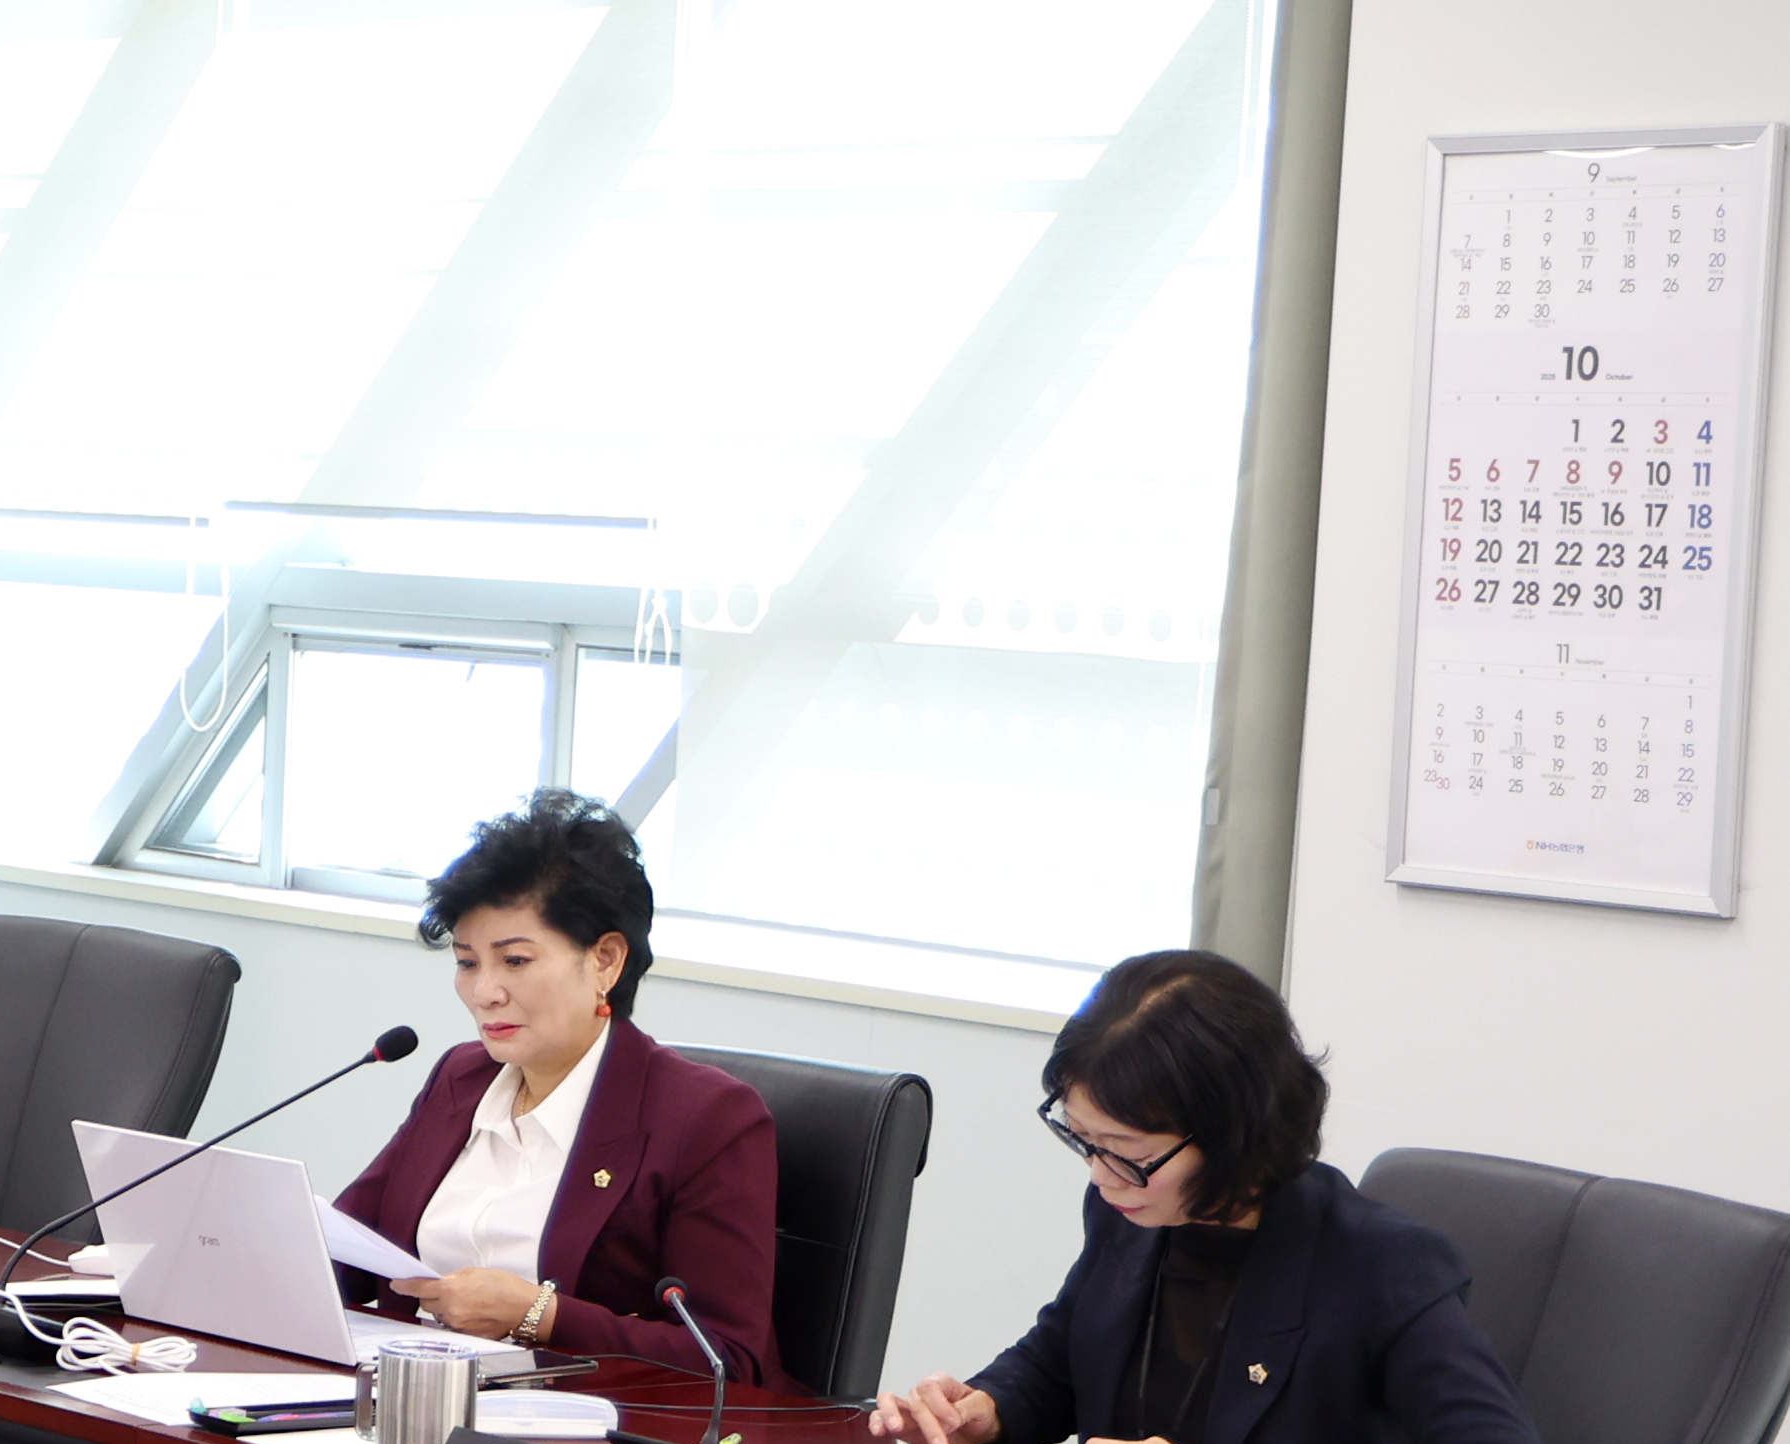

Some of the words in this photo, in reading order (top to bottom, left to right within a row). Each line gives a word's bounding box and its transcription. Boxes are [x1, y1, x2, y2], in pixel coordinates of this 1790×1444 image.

[1588, 163, 1600, 183] 9
[1544, 208, 1553, 223] 2
[1586, 207, 1595, 222] 3
[1628, 206, 1637, 220] 4
[1672, 205, 1681, 220] 5
[1716, 204, 1725, 218] 6
[1464, 234, 1472, 248] 7
[1502, 233, 1511, 248] 8
[1543, 232, 1552, 246] 9
[1582, 231, 1596, 246] 10
[1626, 230, 1636, 244] 11
[1668, 229, 1681, 244] 12
[1713, 227, 1726, 243] 13
[1460, 256, 1472, 272] 14
[1500, 257, 1512, 271] 15
[1540, 256, 1552, 271] 16
[1581, 255, 1594, 269] 17
[1623, 254, 1636, 269] 18
[1667, 253, 1680, 268] 19
[1708, 252, 1726, 268] 20
[1458, 281, 1470, 296] 21
[1496, 280, 1511, 295] 22
[1536, 279, 1552, 294] 23
[1577, 279, 1593, 294] 24
[1619, 278, 1636, 293] 25
[1662, 278, 1679, 293] 26
[1707, 277, 1724, 292] 27
[1455, 304, 1471, 319] 28
[1495, 304, 1510, 319] 29
[1534, 303, 1550, 318] 30
[1562, 345, 1599, 381] 10
[1610, 419, 1625, 444] 2
[1653, 419, 1668, 445] 3
[1697, 420, 1713, 445] 4
[1448, 458, 1461, 482] 5
[1486, 459, 1500, 483] 6
[1527, 459, 1540, 483] 7
[1566, 459, 1580, 485] 8
[1608, 460, 1623, 485] 9
[1646, 461, 1671, 486] 10
[1693, 462, 1711, 487] 11
[1442, 497, 1463, 522] 12
[1480, 499, 1502, 523] 13
[1520, 500, 1542, 524] 14
[1560, 501, 1582, 526] 15
[1602, 502, 1625, 527] 16
[1645, 503, 1668, 527] 17
[1688, 504, 1712, 529] 18
[1440, 538, 1462, 561] 19
[1475, 538, 1502, 564] 20
[1516, 540, 1539, 565] 21
[1554, 541, 1583, 566] 22
[1596, 542, 1625, 568] 23
[1638, 544, 1669, 569] 24
[1682, 545, 1712, 571] 25
[1435, 577, 1462, 602] 26
[1474, 579, 1500, 603] 27
[1512, 580, 1540, 606] 28
[1552, 582, 1581, 607] 29
[1593, 584, 1623, 609] 30
[1638, 585, 1662, 611] 31
[1556, 643, 1570, 664] 11
[1437, 703, 1444, 717] 2
[1475, 705, 1484, 720] 3
[1515, 707, 1523, 722] 4
[1555, 711, 1564, 726] 5
[1597, 714, 1606, 728] 6
[1641, 716, 1650, 730] 7
[1684, 719, 1693, 734] 8
[1435, 726, 1444, 740] 9
[1472, 729, 1485, 744] 10
[1513, 732, 1523, 746] 11
[1553, 734, 1565, 749] 12
[1595, 737, 1607, 752] 13
[1638, 740, 1651, 755] 14
[1681, 743, 1695, 758] 15
[1433, 749, 1445, 764] 16
[1472, 752, 1484, 766] 17
[1511, 755, 1523, 770] 18
[1552, 758, 1565, 772] 19
[1592, 761, 1608, 776] 20
[1635, 764, 1649, 779] 21
[1678, 767, 1695, 783] 22
[1469, 775, 1483, 790] 24
[1508, 778, 1524, 793] 25
[1549, 781, 1565, 797] 26
[1591, 785, 1607, 799] 27
[1633, 788, 1650, 803] 28
[1676, 791, 1693, 806] 29
